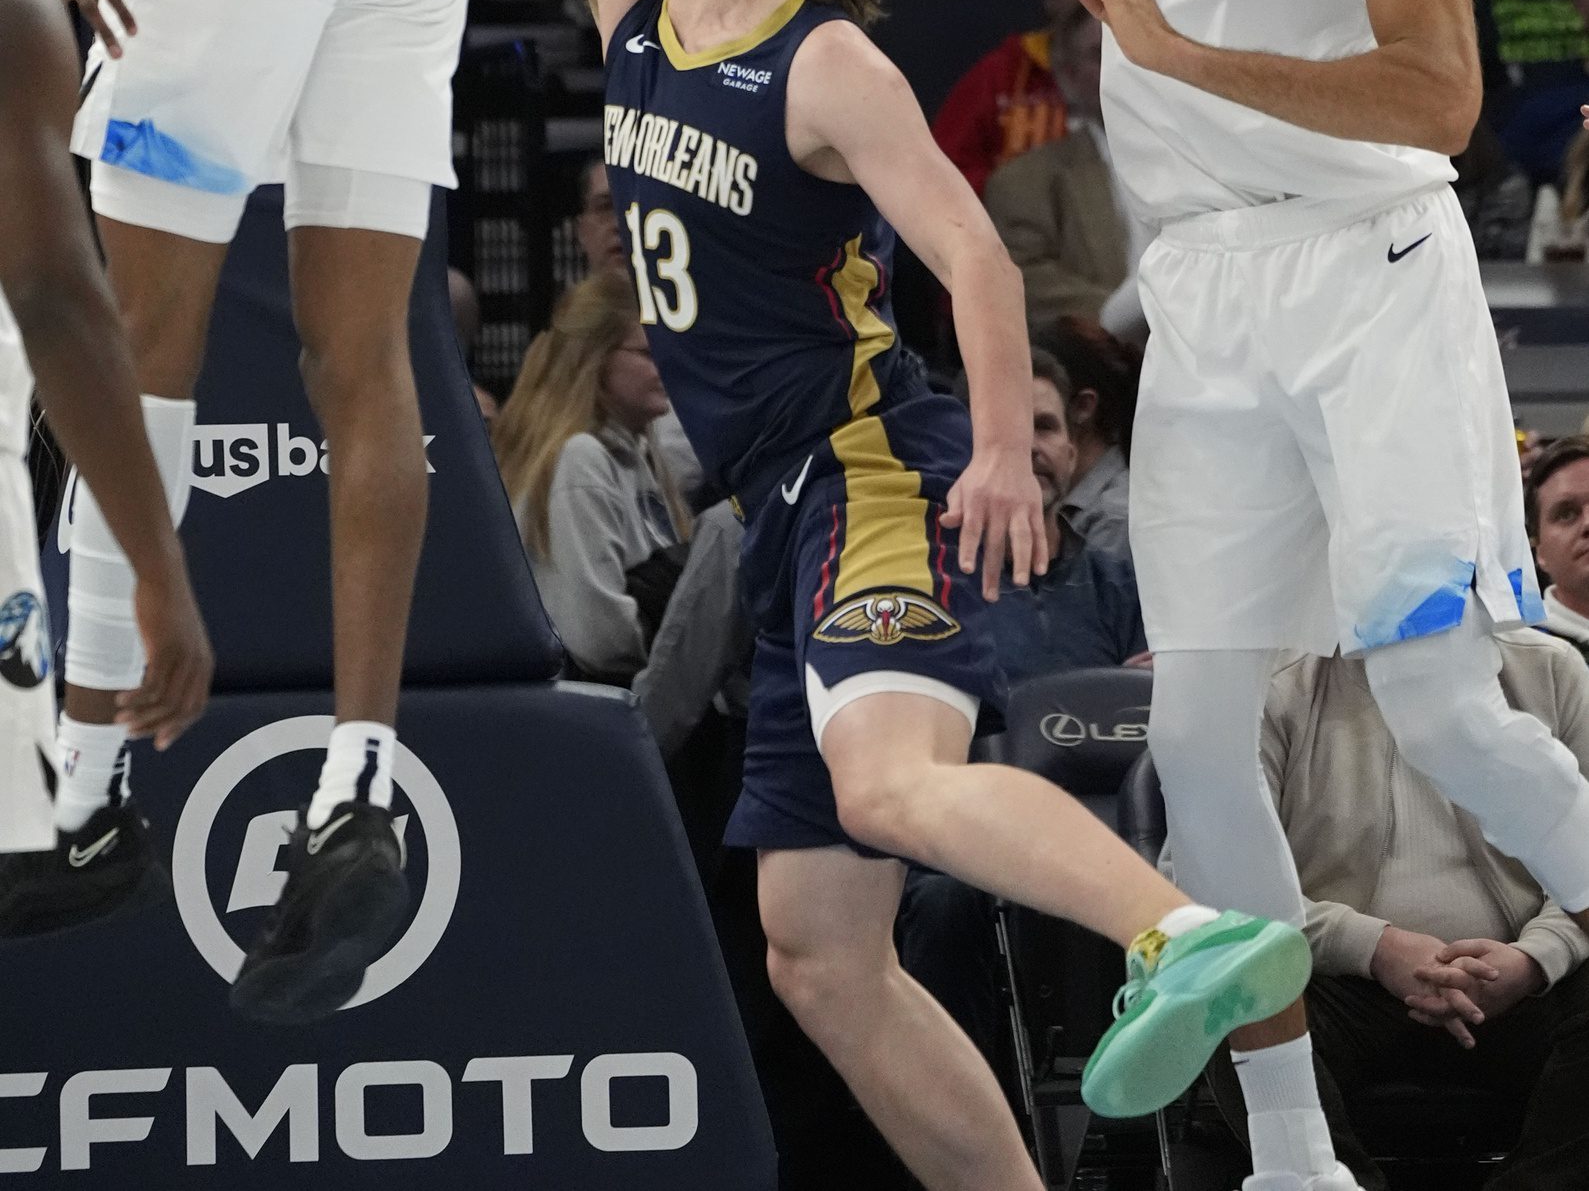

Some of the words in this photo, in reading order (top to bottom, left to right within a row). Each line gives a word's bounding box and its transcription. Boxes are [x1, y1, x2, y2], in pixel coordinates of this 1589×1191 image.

[717, 61, 773, 85] NEWAGE
[722, 78, 759, 93] GARAGE
[604, 104, 642, 169] EW
[633, 113, 758, 217] ORLEANS
[624, 201, 699, 333] 13
[192, 437, 261, 478] us
